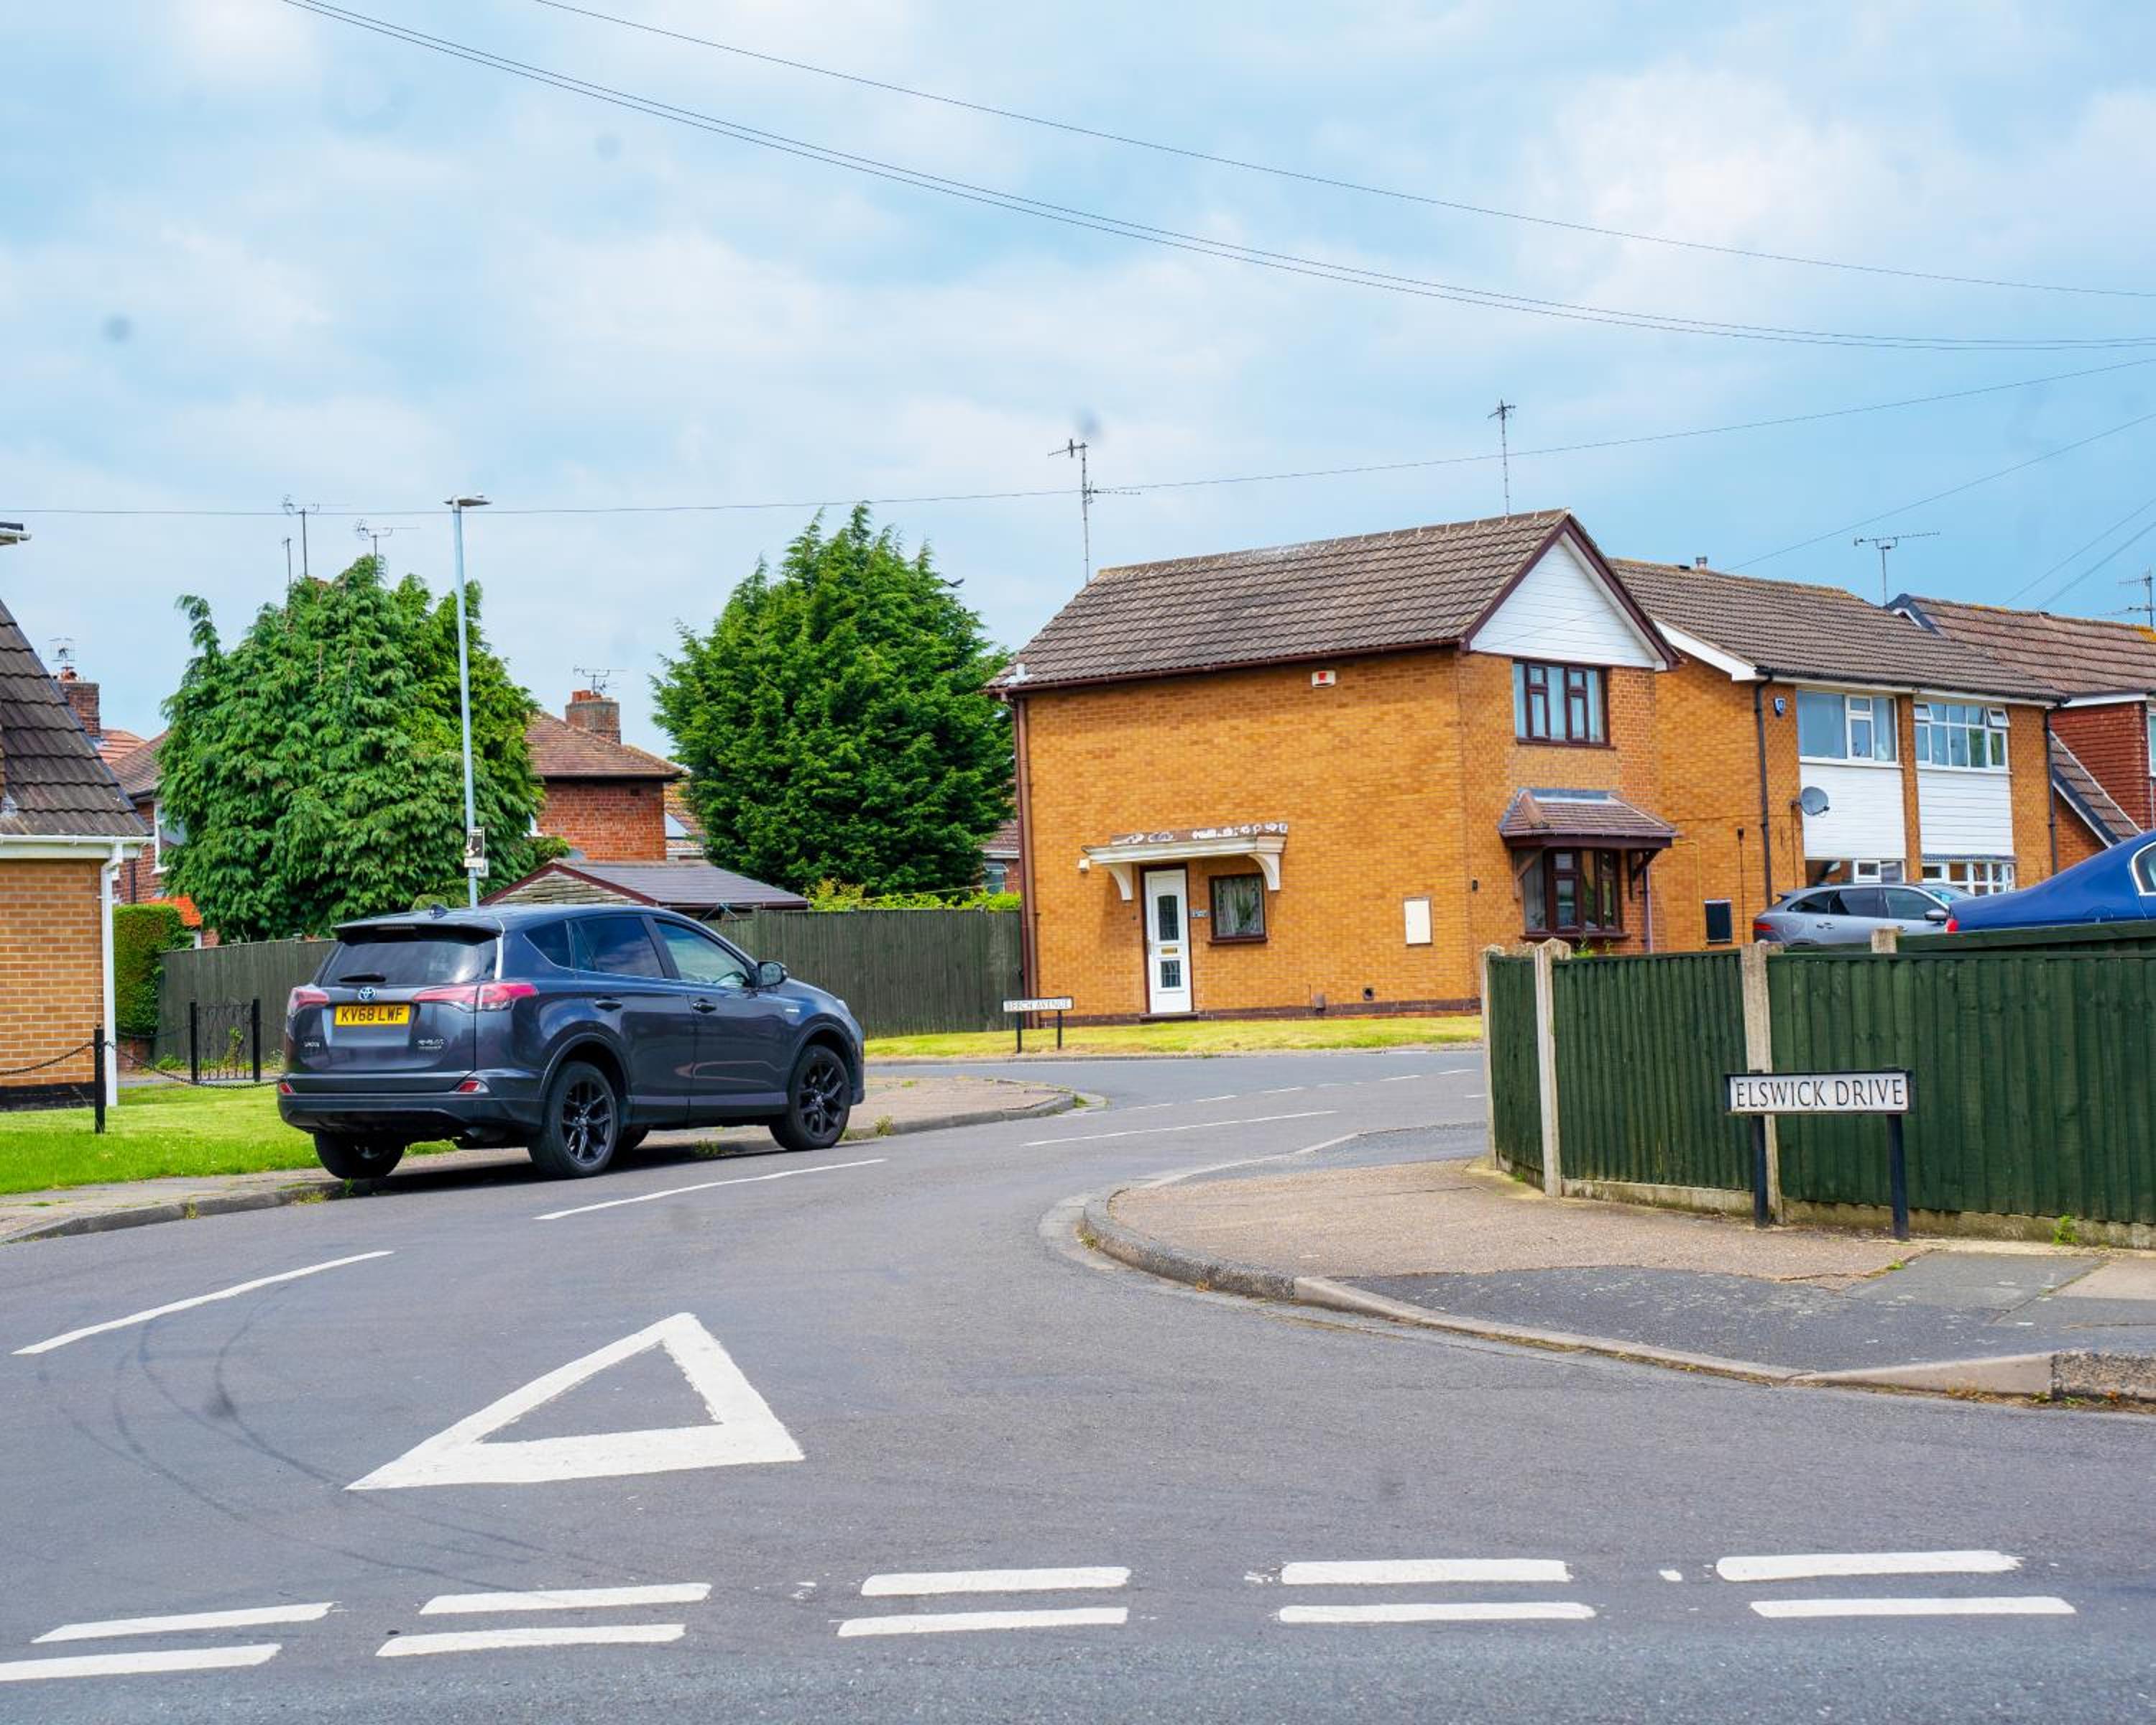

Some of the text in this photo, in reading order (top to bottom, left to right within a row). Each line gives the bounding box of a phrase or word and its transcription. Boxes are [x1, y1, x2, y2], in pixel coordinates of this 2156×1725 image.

[1036, 1000, 1069, 1009] AVENUE
[341, 1007, 405, 1023] KV68 LWF
[1736, 1079, 1904, 1108] ELSWICK DRIVE
